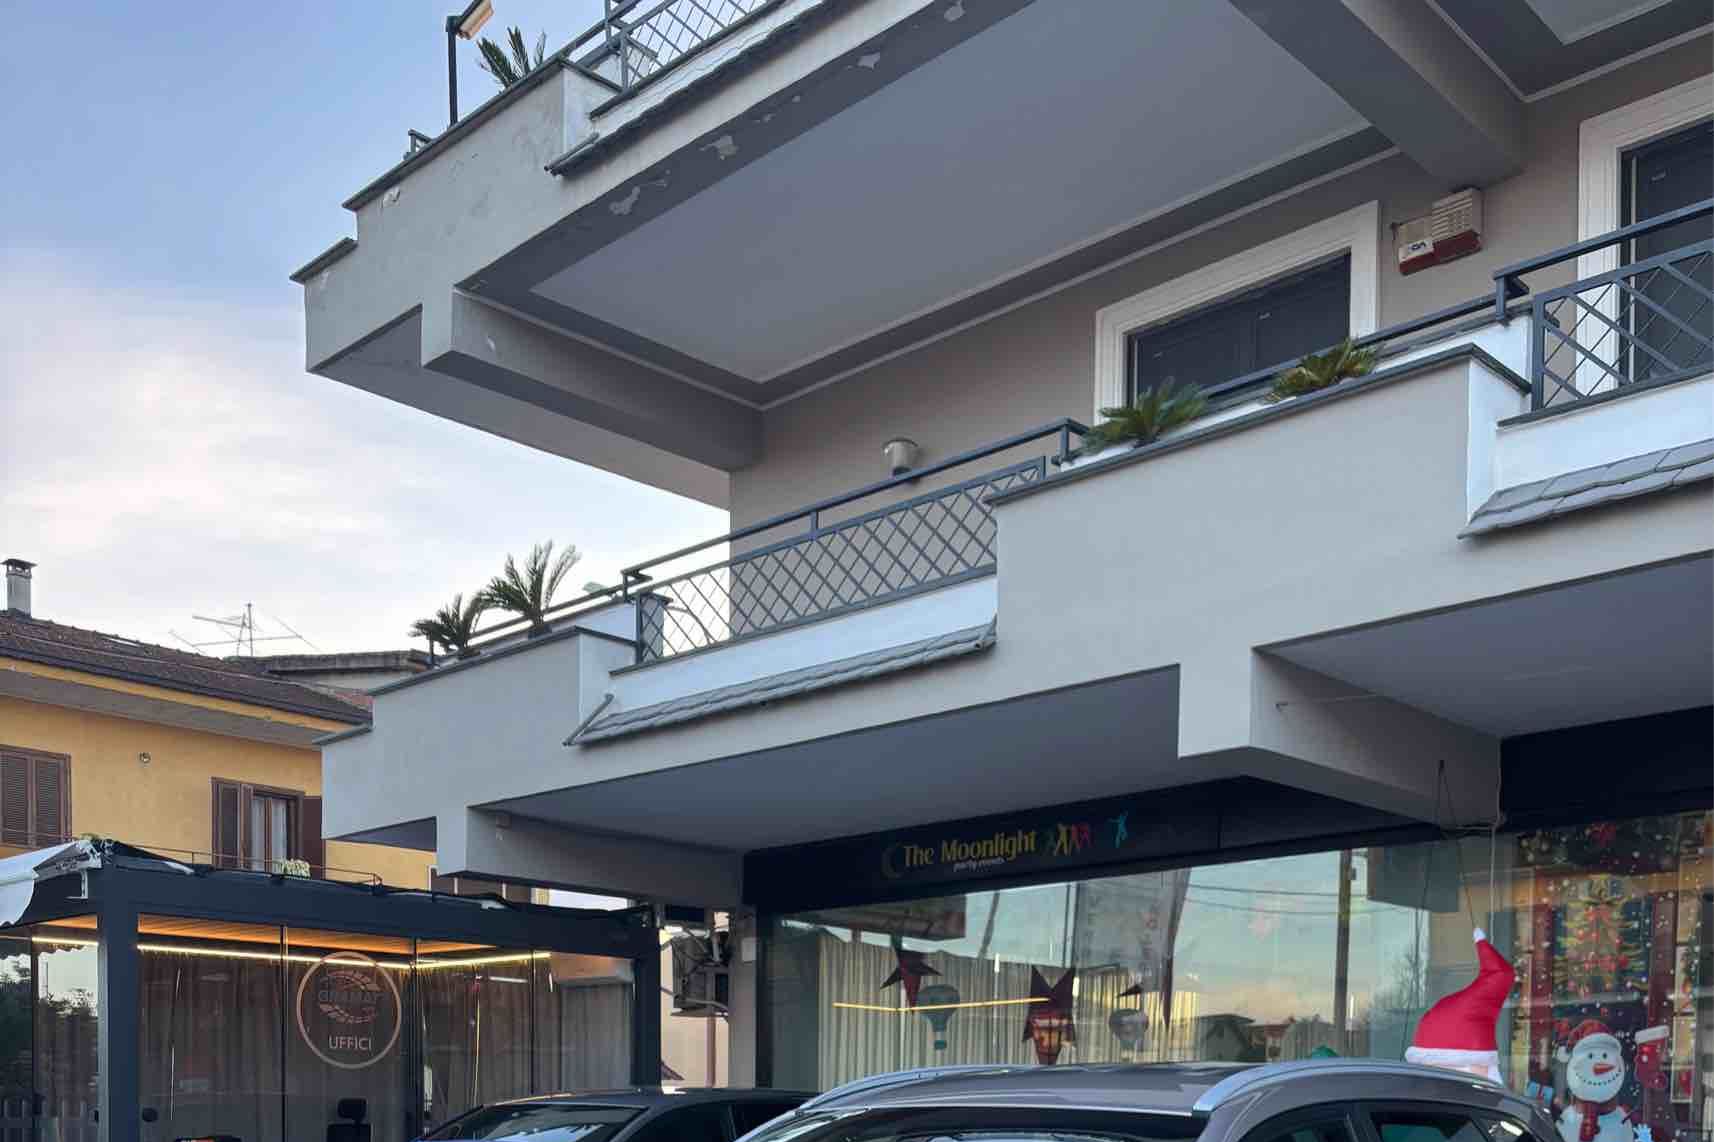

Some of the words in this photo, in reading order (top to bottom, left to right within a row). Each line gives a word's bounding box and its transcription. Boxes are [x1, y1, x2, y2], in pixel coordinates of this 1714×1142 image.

[904, 845, 935, 867] The
[941, 829, 1037, 862] Moonlight
[328, 1035, 372, 1052] UFFICI
